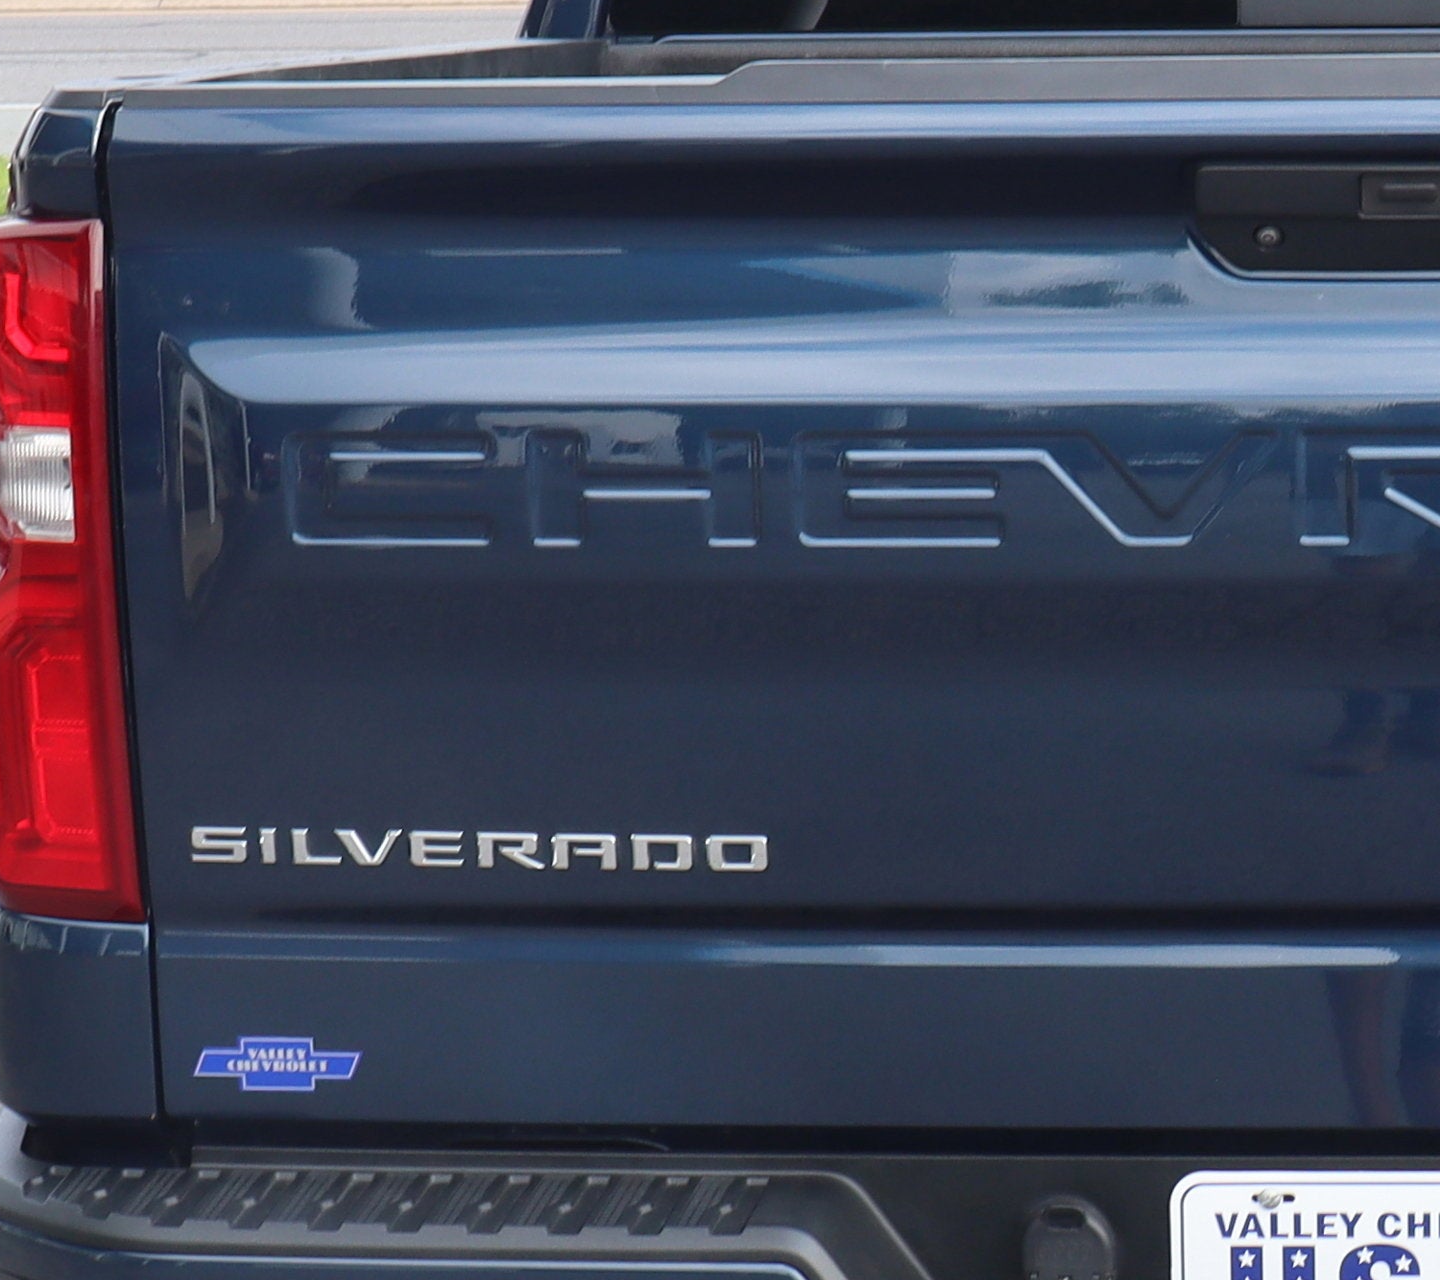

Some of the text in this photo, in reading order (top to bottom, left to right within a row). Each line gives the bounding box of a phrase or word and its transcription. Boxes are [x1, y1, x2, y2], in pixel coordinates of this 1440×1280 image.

[191, 826, 769, 872] SILVERADO
[247, 1047, 306, 1060] VALLEY
[227, 1059, 328, 1073] CHEVROLET
[1215, 1213, 1362, 1239] VALLEY
